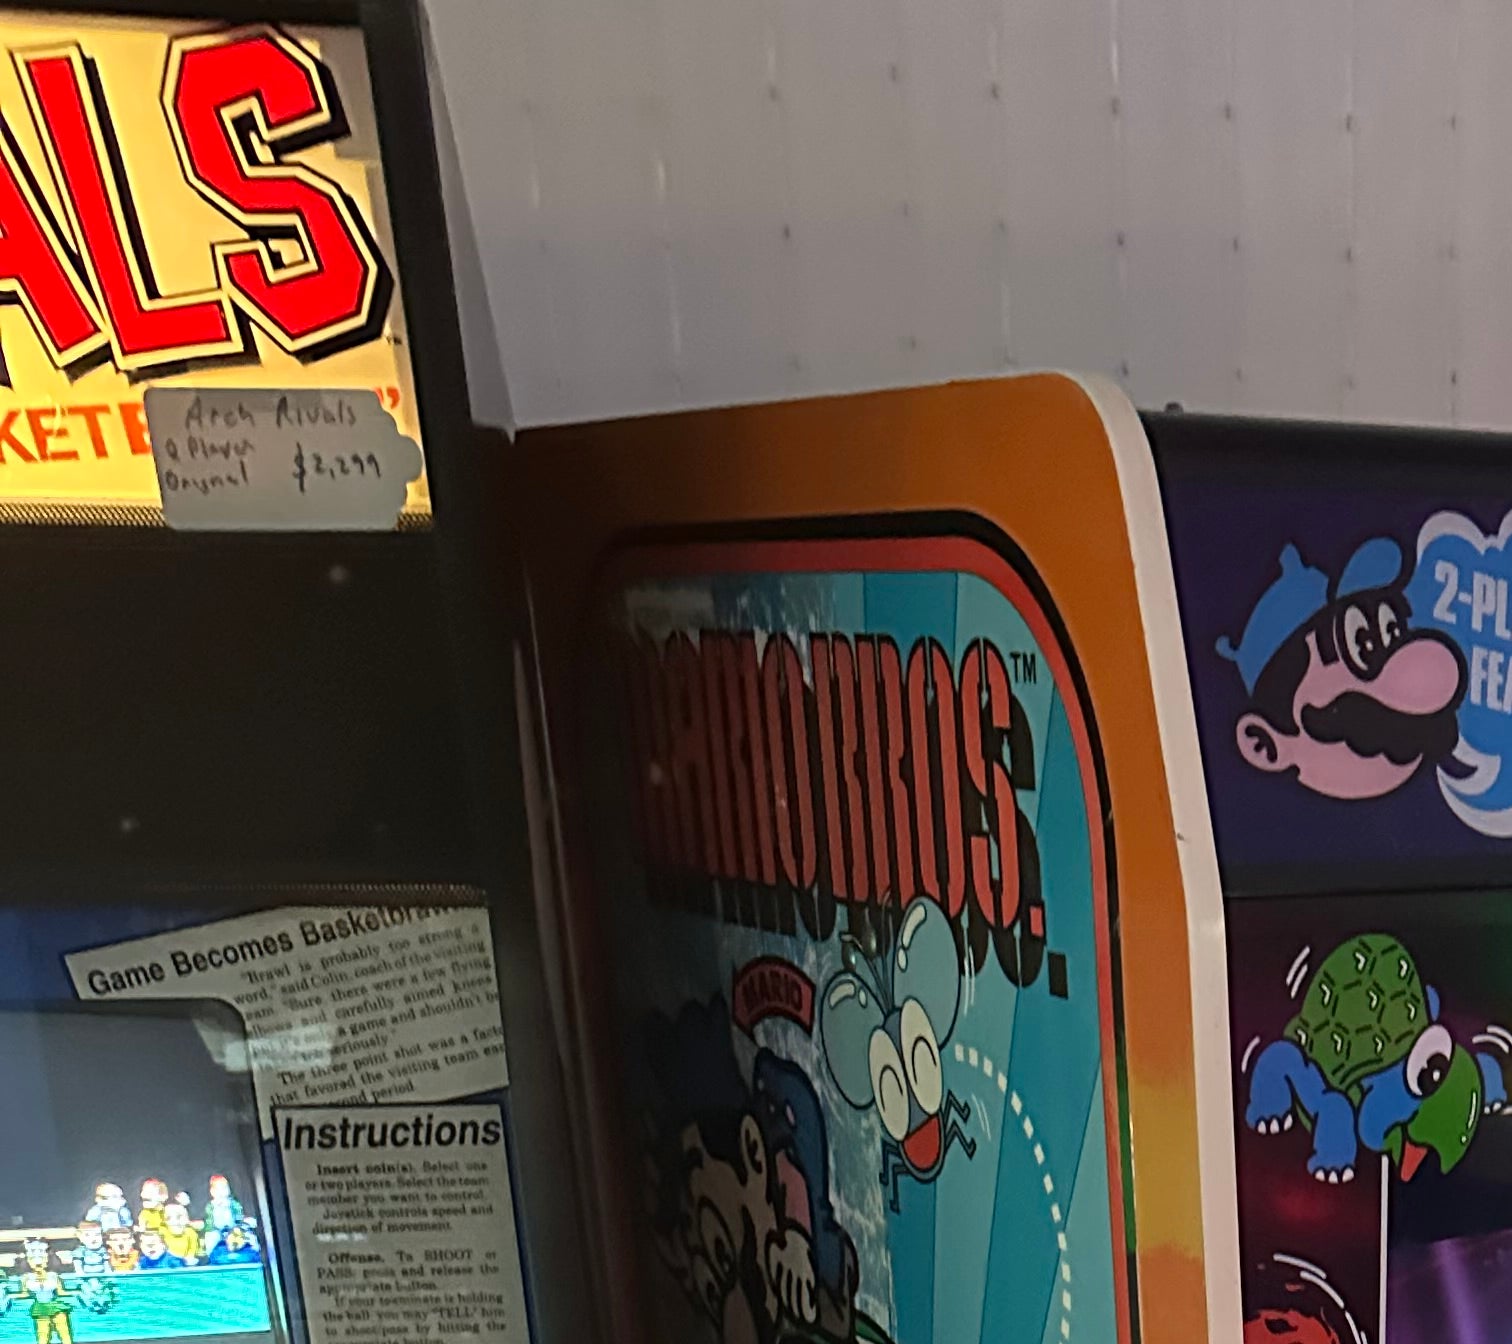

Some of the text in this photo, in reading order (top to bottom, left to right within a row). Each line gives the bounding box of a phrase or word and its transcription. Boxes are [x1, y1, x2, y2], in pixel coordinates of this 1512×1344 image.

[185, 396, 356, 429] Arch Rivals
[165, 460, 248, 494] Original
[293, 442, 381, 494] $2,299
[88, 960, 166, 997] Game
[171, 929, 294, 978] Becomes
[284, 1114, 500, 1150] Instructions
